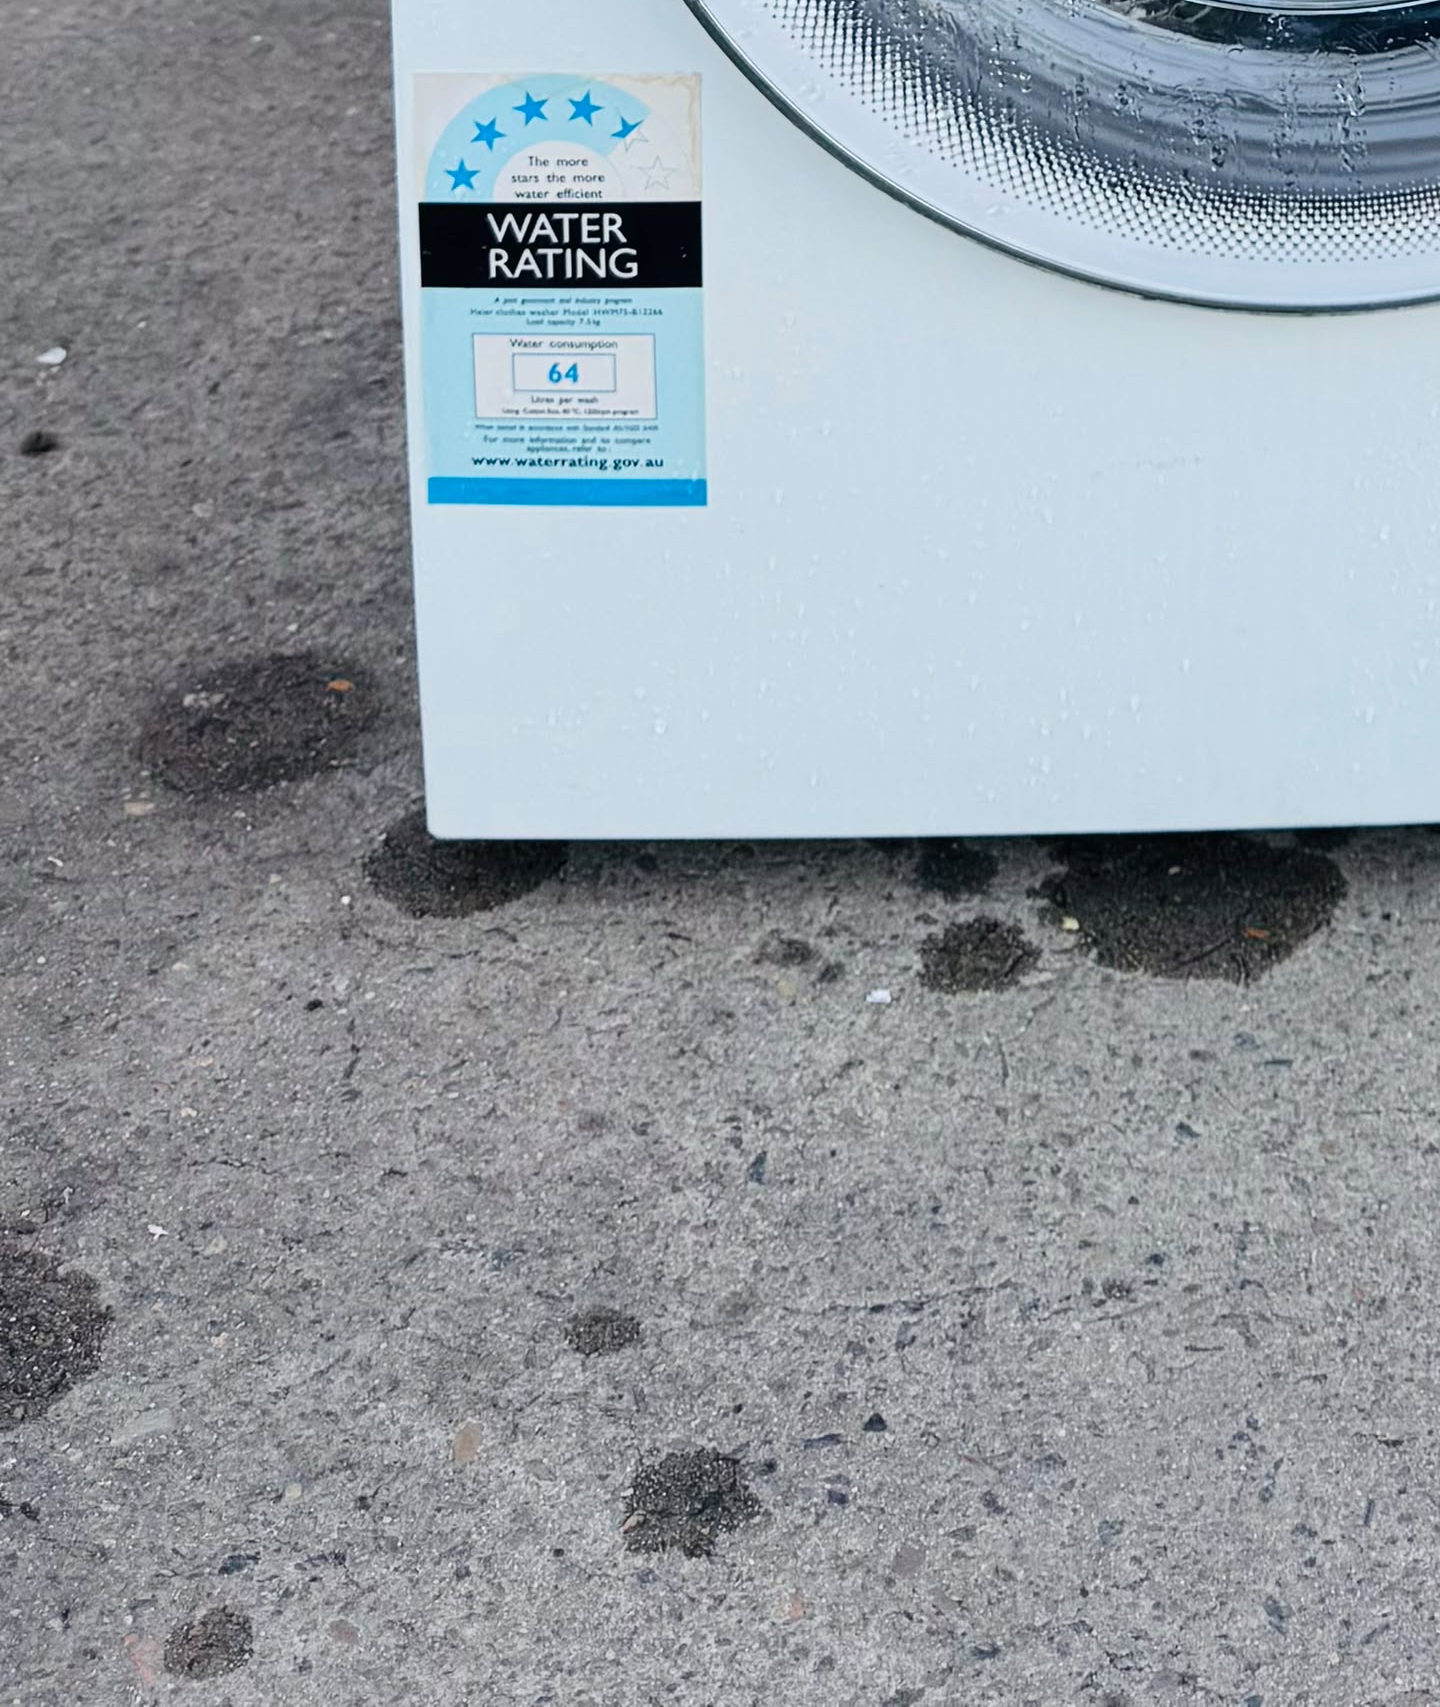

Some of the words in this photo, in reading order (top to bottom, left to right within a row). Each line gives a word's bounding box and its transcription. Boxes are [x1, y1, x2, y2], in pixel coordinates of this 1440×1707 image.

[528, 155, 550, 167] The
[556, 158, 589, 167] more
[511, 174, 540, 183] stars
[547, 172, 566, 183] the
[573, 174, 606, 183] more
[514, 190, 550, 199] water
[556, 188, 603, 199] efficient
[486, 212, 627, 244] WATER
[488, 248, 639, 280] RATING
[510, 339, 543, 348] Water
[549, 340, 618, 350] consumption
[548, 362, 580, 384] 64
[472, 456, 664, 471] www.waterrating.gov.au
